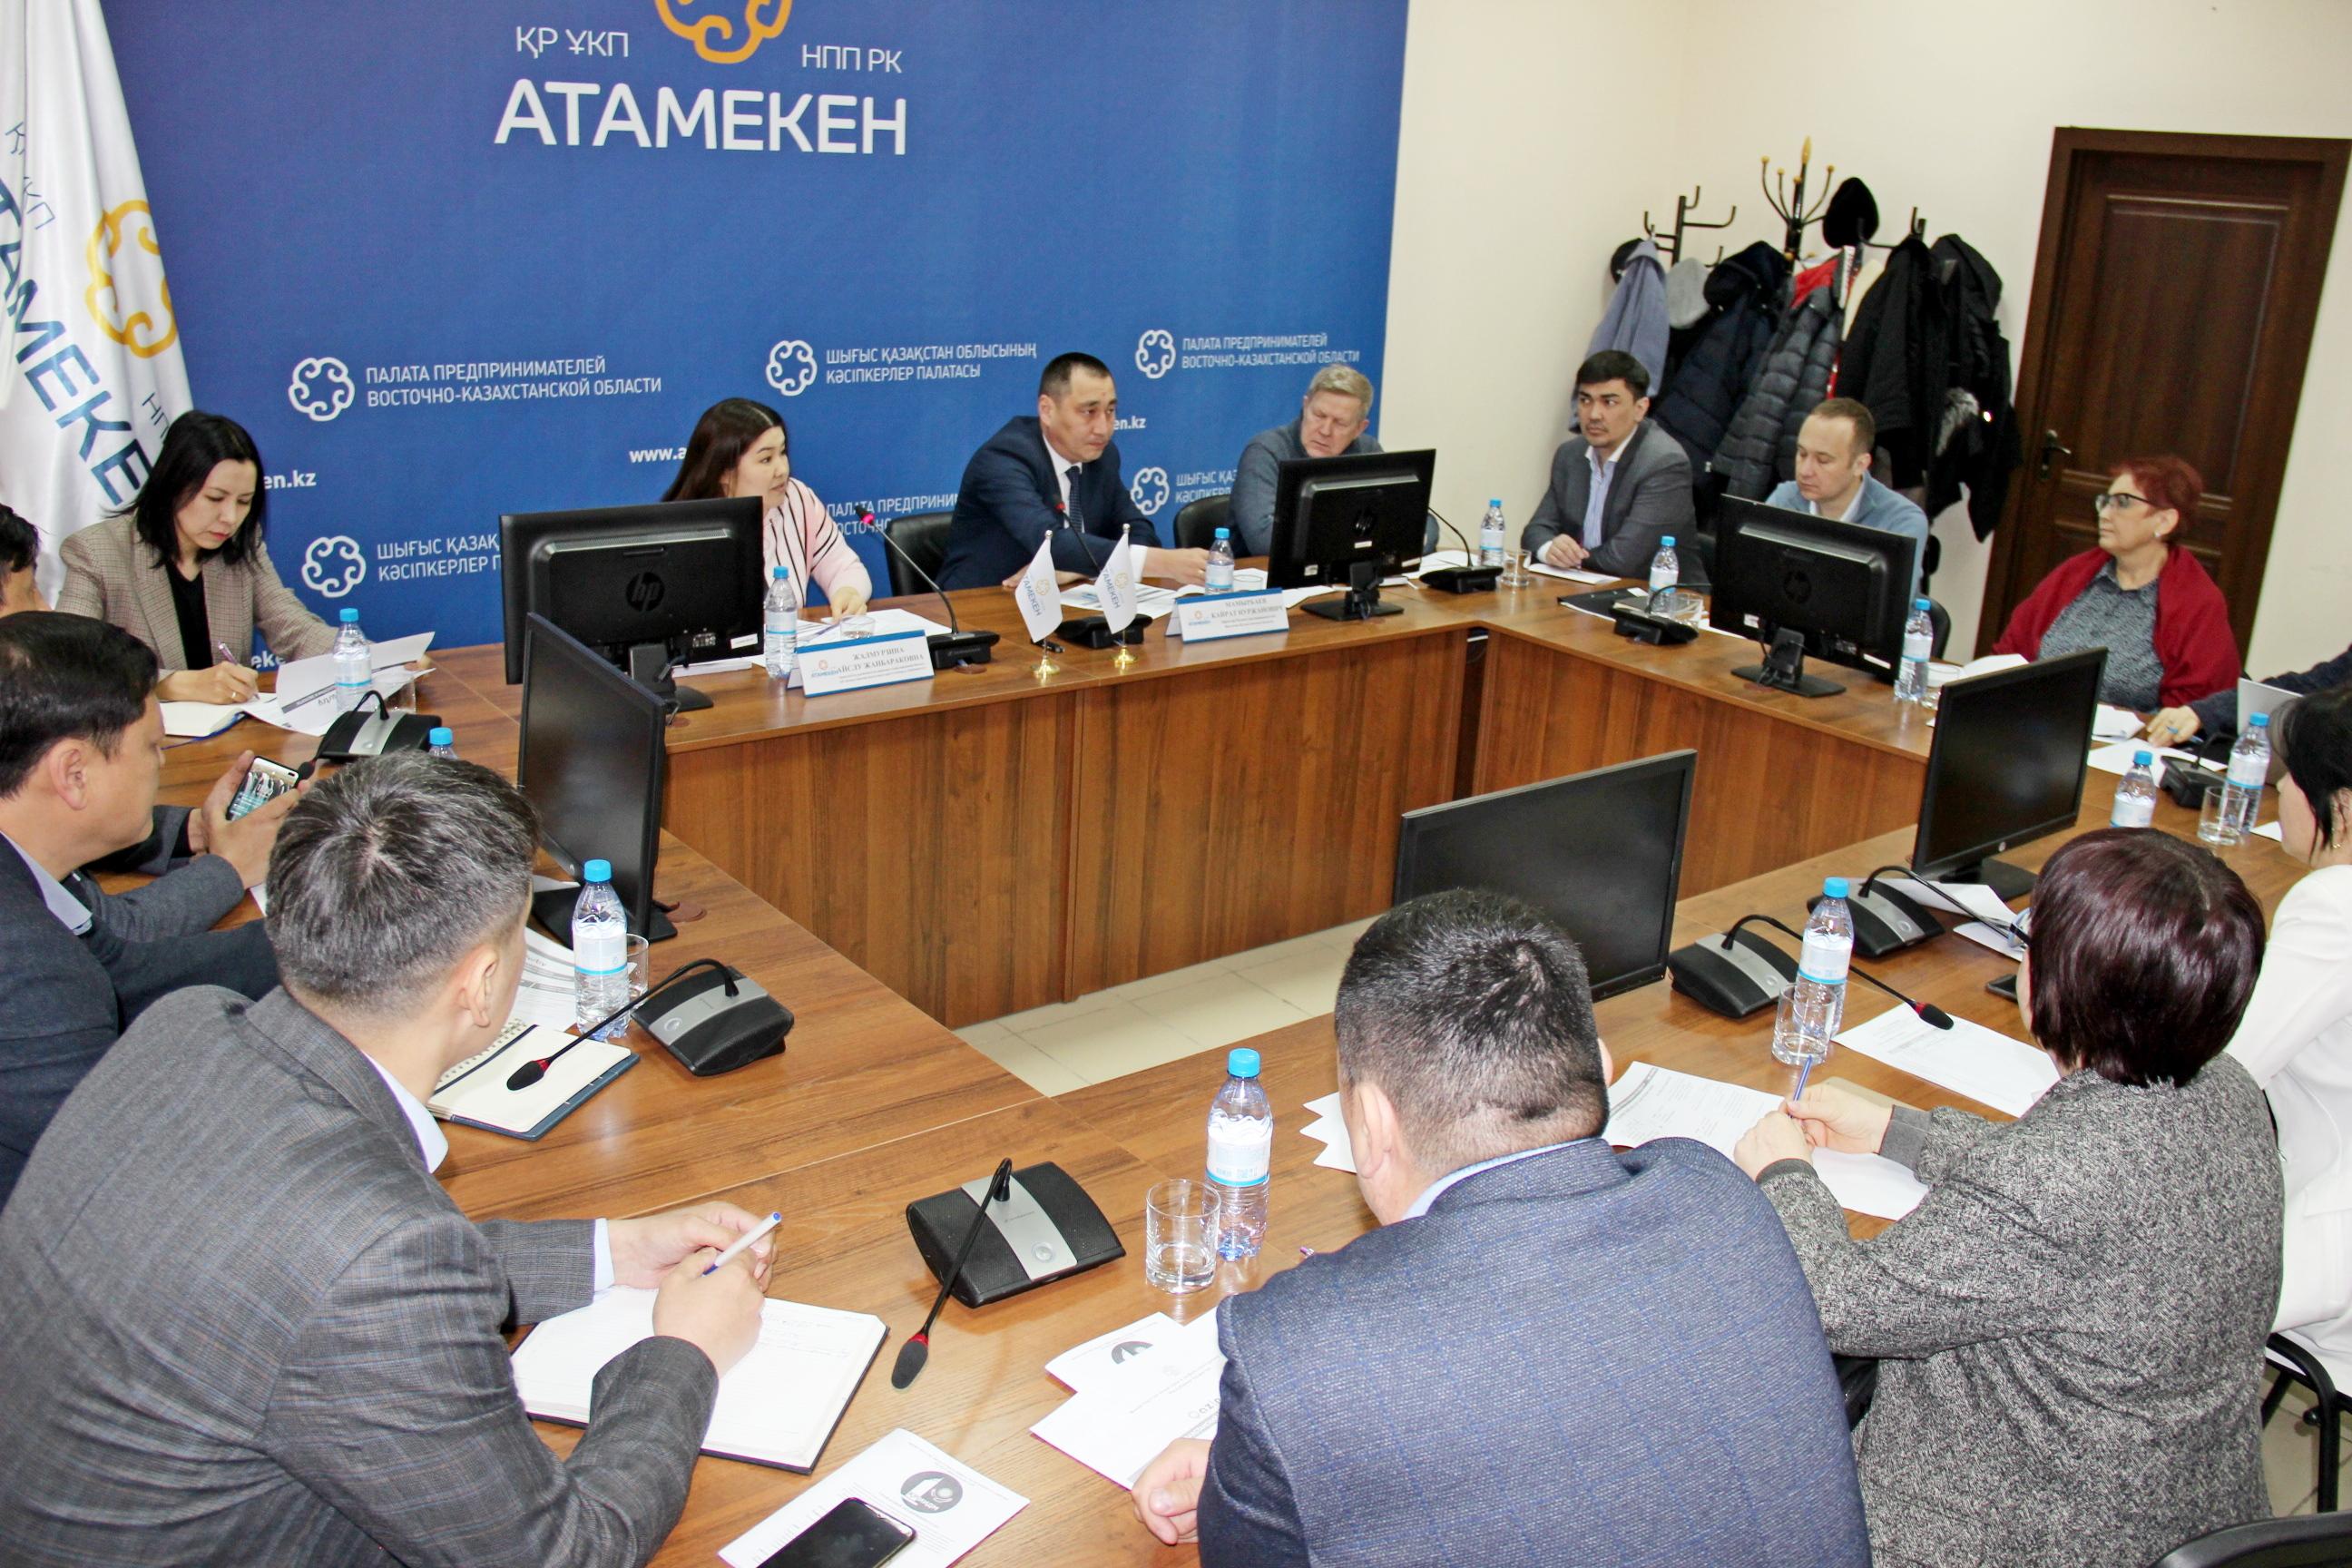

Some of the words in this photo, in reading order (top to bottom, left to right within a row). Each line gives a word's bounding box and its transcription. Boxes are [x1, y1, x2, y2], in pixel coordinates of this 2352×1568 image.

[515, 26, 558, 59] ҚР
[565, 29, 630, 58] ҰКП
[801, 44, 861, 72] НПП
[867, 48, 903, 74] РК
[494, 78, 906, 155] АТАМЕКЕН
[827, 348, 878, 365] ШЫҒЫС
[882, 345, 953, 365] ҚАЗАҚСТАН
[956, 343, 1037, 359] ОБЛЫСЫНЫҢ
[1182, 338, 1221, 351] ПАЛАТА
[1223, 332, 1328, 350] ПРЕДПРИНИМАТЕЛЕЙ
[366, 365, 430, 384] ПАЛАТА
[434, 355, 606, 381] ПРЕДПРИНИМАТЕЛЕЙ
[1181, 349, 1317, 368] ВОСТОЧНО-КАЗАХСТАНСКОЙ
[1318, 350, 1360, 364] ОБЛАСТИ
[826, 366, 915, 384] КӘСІПКЕРЛЕР
[916, 364, 981, 380] ПАЛАТАСЫ
[368, 377, 590, 407] ВОСТОЧНО-КАЗАХСТАНСКОЙ
[593, 377, 662, 396] ОБЛАСТИ
[1176, 471, 1217, 486] ШЫҒЫС
[377, 539, 443, 560] ШЫҒЫС
[446, 534, 501, 556] ҚАЗАҚ
[378, 556, 489, 582] КӘСІПКЕРЛЕР
